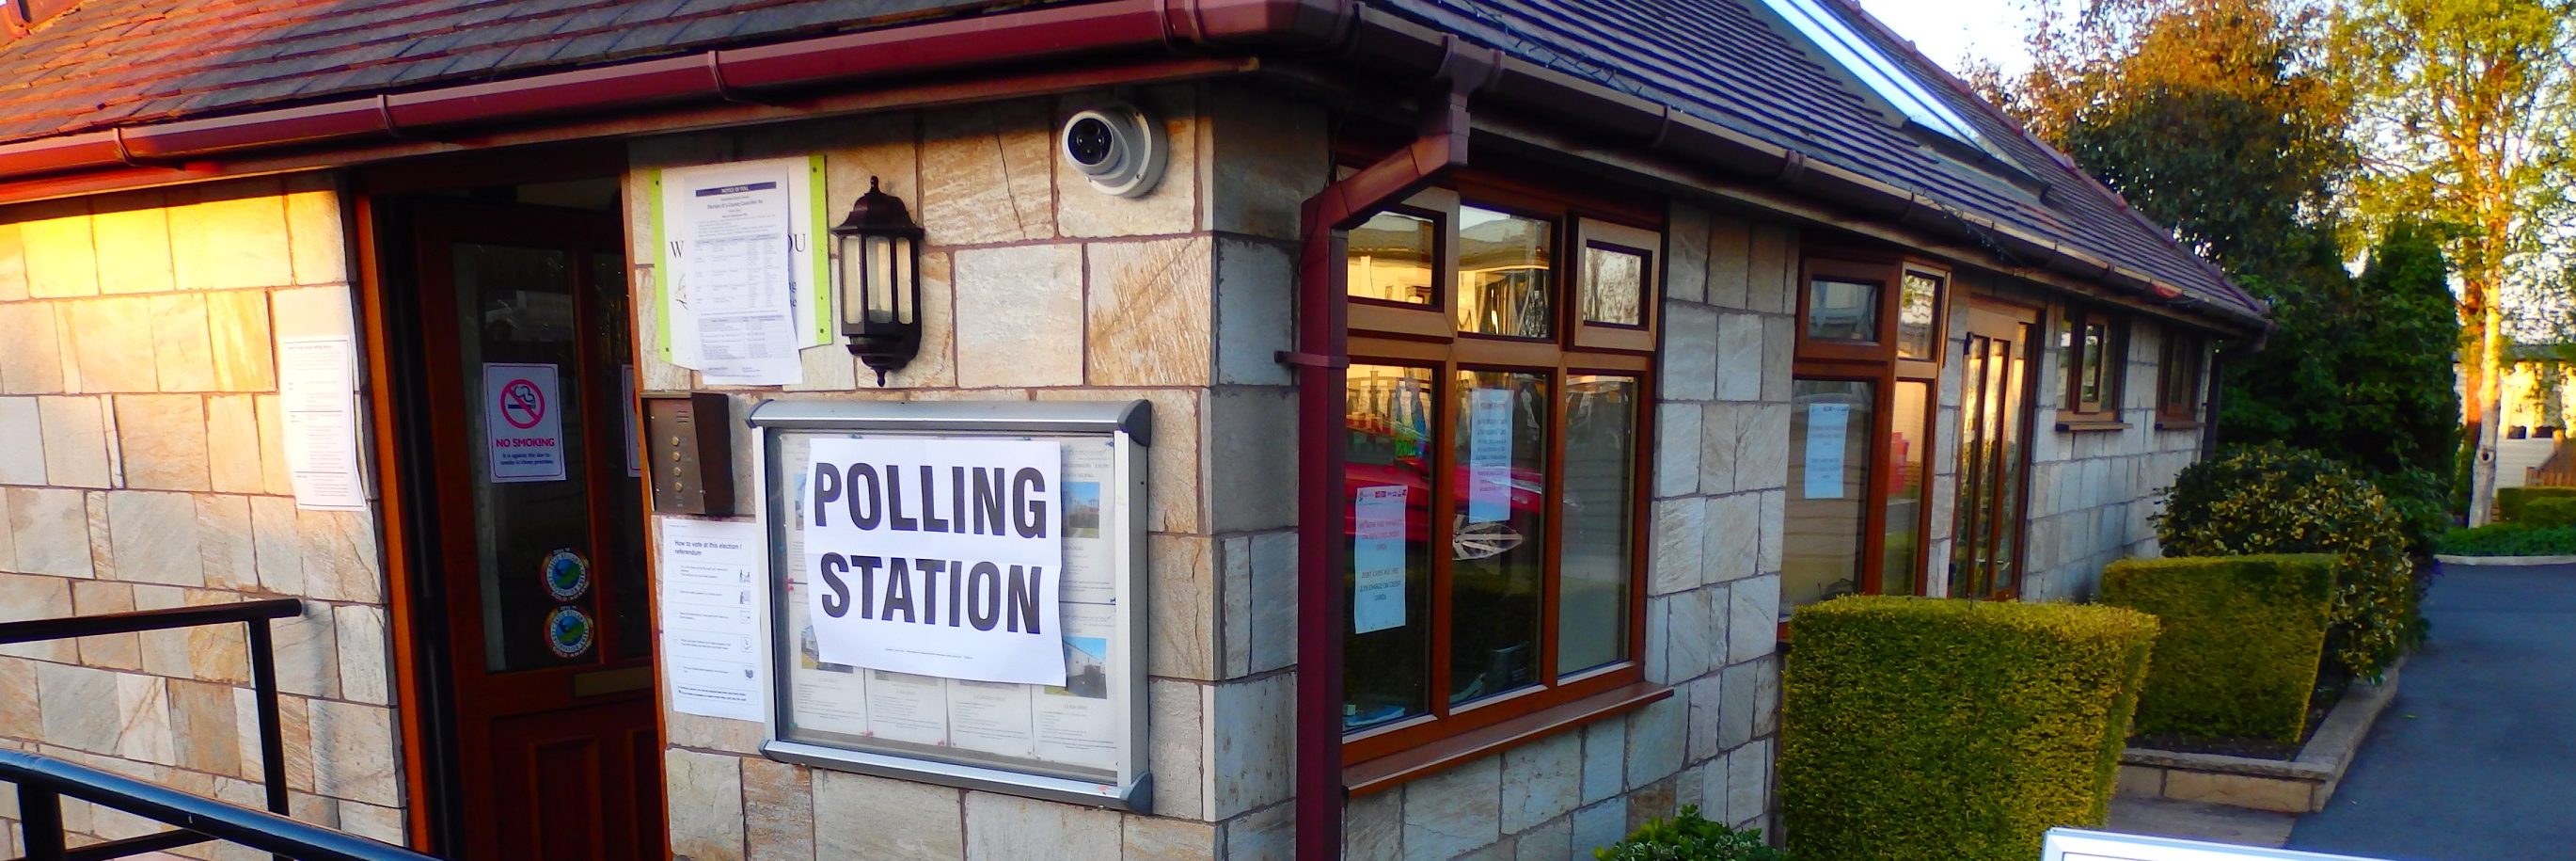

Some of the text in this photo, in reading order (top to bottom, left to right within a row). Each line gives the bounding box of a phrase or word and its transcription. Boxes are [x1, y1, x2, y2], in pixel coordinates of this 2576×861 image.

[496, 438, 556, 448] NO SMOKING
[814, 462, 1047, 539] POLLING
[820, 552, 1042, 635] STATION
